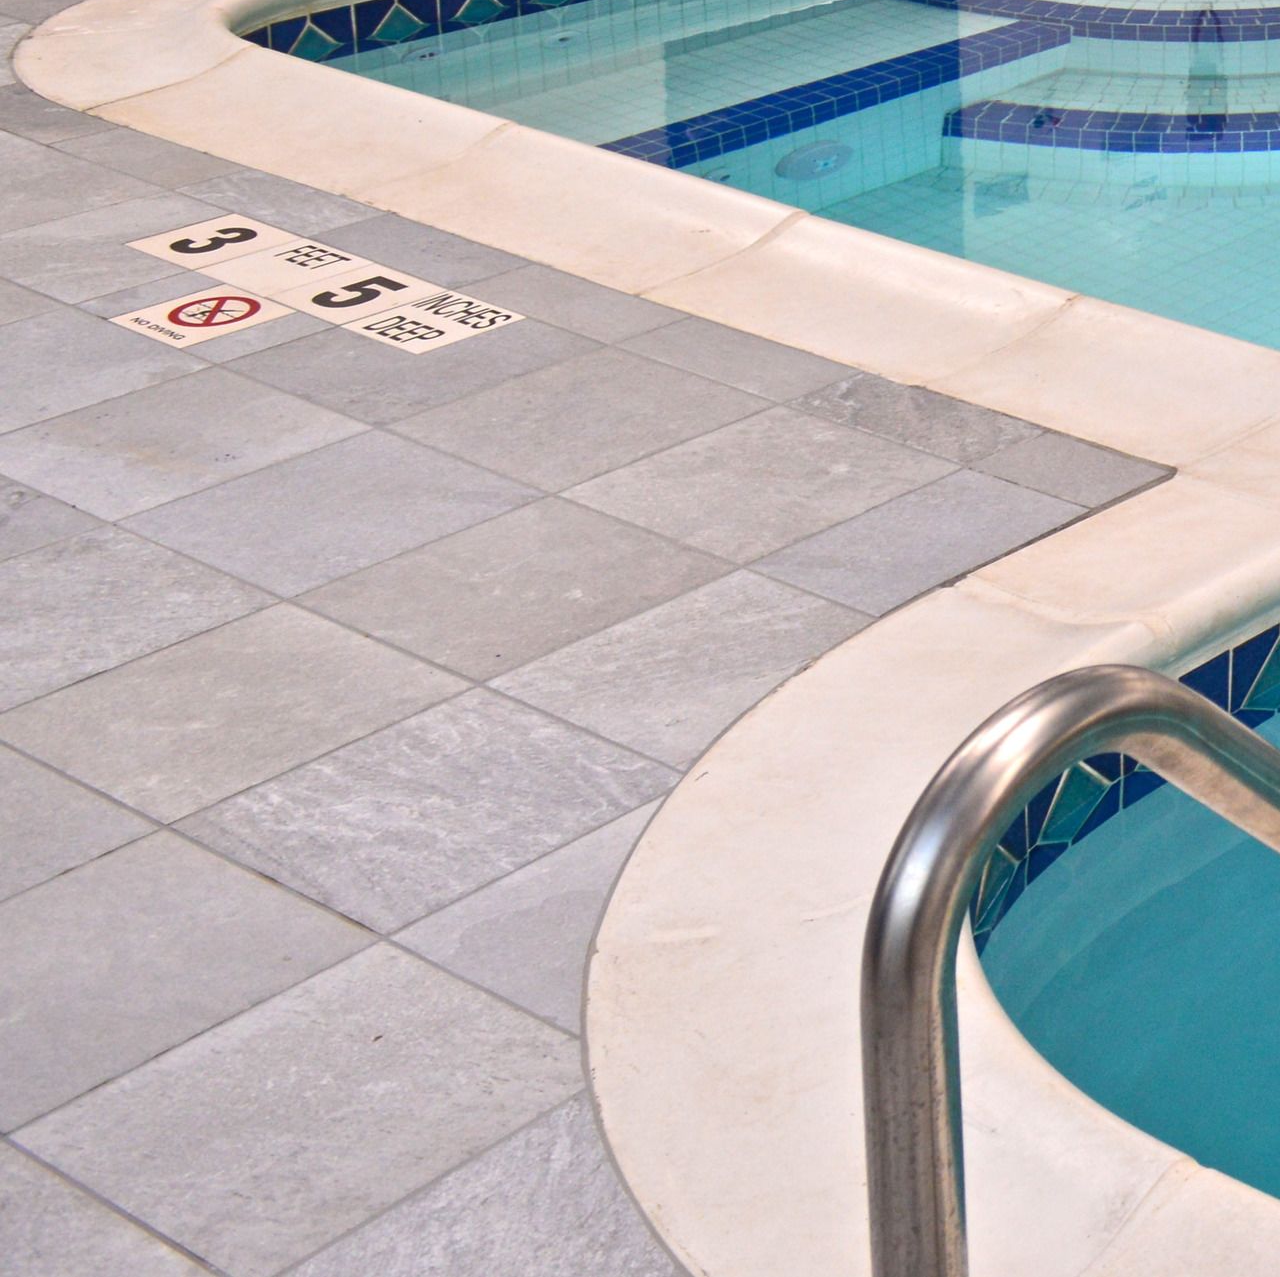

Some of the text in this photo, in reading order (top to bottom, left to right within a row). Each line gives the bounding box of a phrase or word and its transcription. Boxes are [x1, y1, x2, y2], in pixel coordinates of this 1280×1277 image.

[169, 227, 409, 309] 3 FEET 5
[411, 293, 512, 330] INCHES
[130, 317, 186, 340] NO DIVING
[362, 315, 446, 344] DEEP
